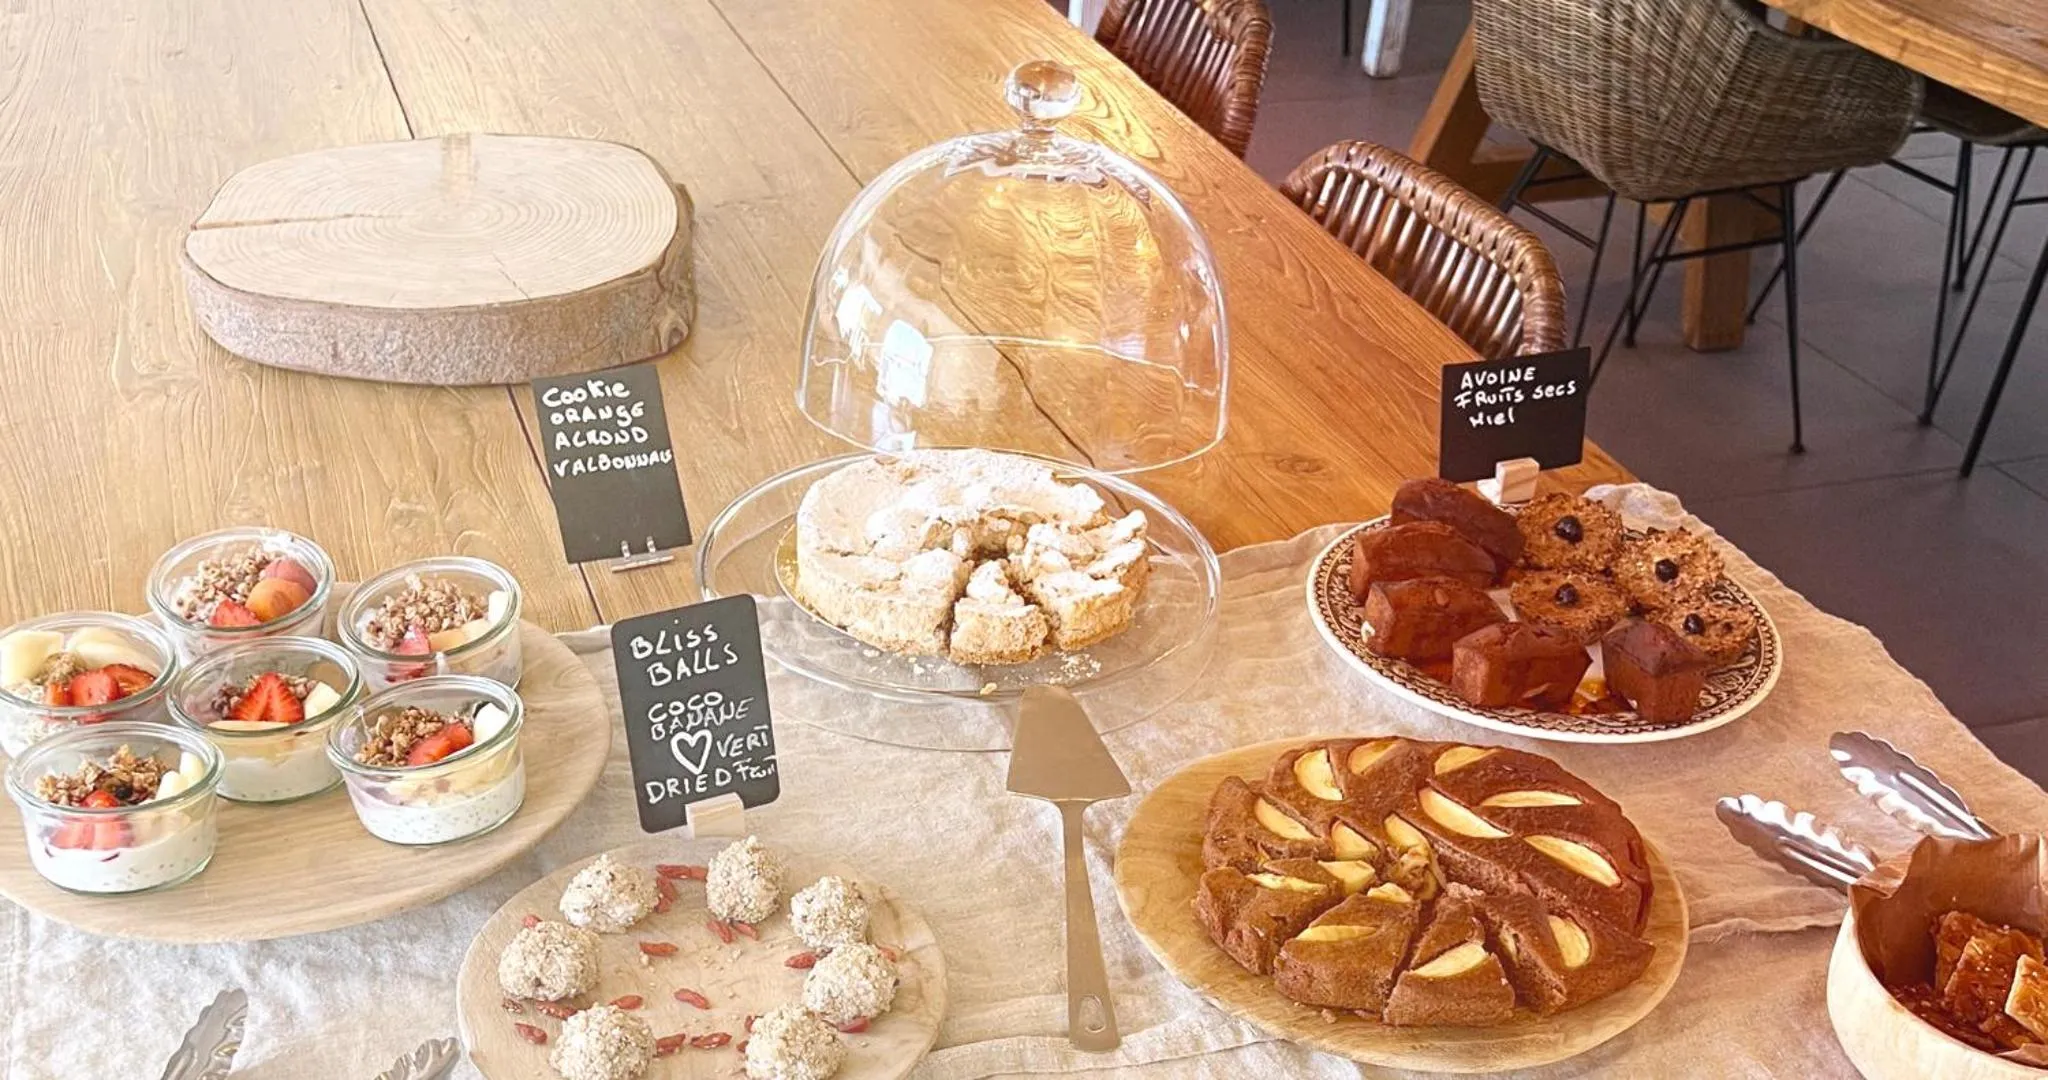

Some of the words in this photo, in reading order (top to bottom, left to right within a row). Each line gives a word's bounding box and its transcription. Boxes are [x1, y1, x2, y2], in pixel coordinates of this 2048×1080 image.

[1460, 367, 1536, 391] AVOINE
[550, 401, 645, 427] ORANGE
[646, 643, 739, 687] BALLS
[648, 691, 723, 723] COCO
[650, 697, 754, 741] BANANE
[716, 724, 770, 758] VERT
[645, 768, 732, 804] DRIED
